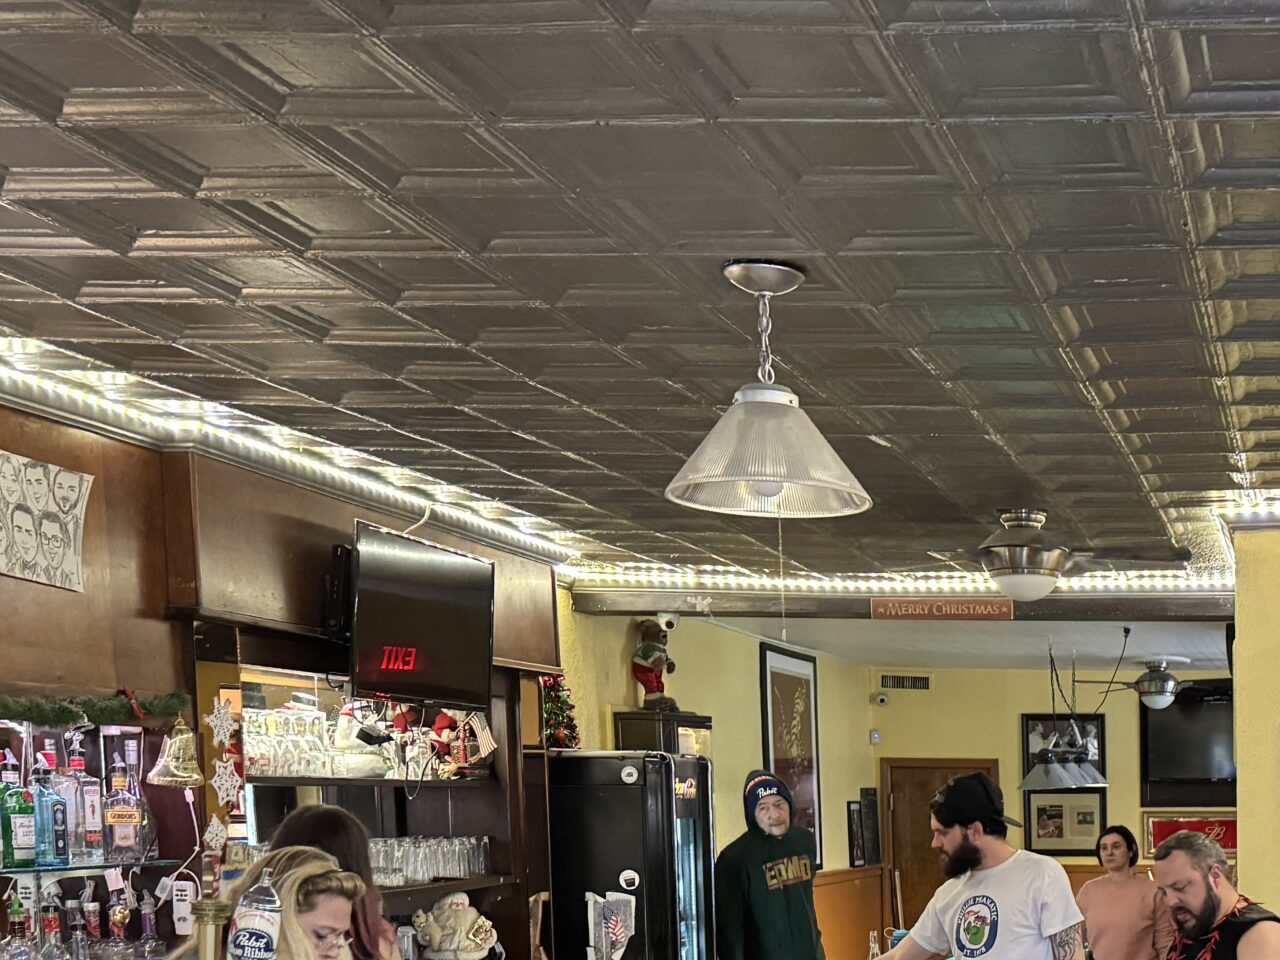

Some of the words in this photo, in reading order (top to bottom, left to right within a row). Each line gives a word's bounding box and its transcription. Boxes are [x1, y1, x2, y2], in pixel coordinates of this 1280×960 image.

[887, 603, 930, 616] MERRY
[933, 602, 999, 616] CHRISTMAS
[756, 786, 778, 799] Pabst
[975, 896, 998, 921] PHANATIC
[236, 931, 268, 948] Pabst
